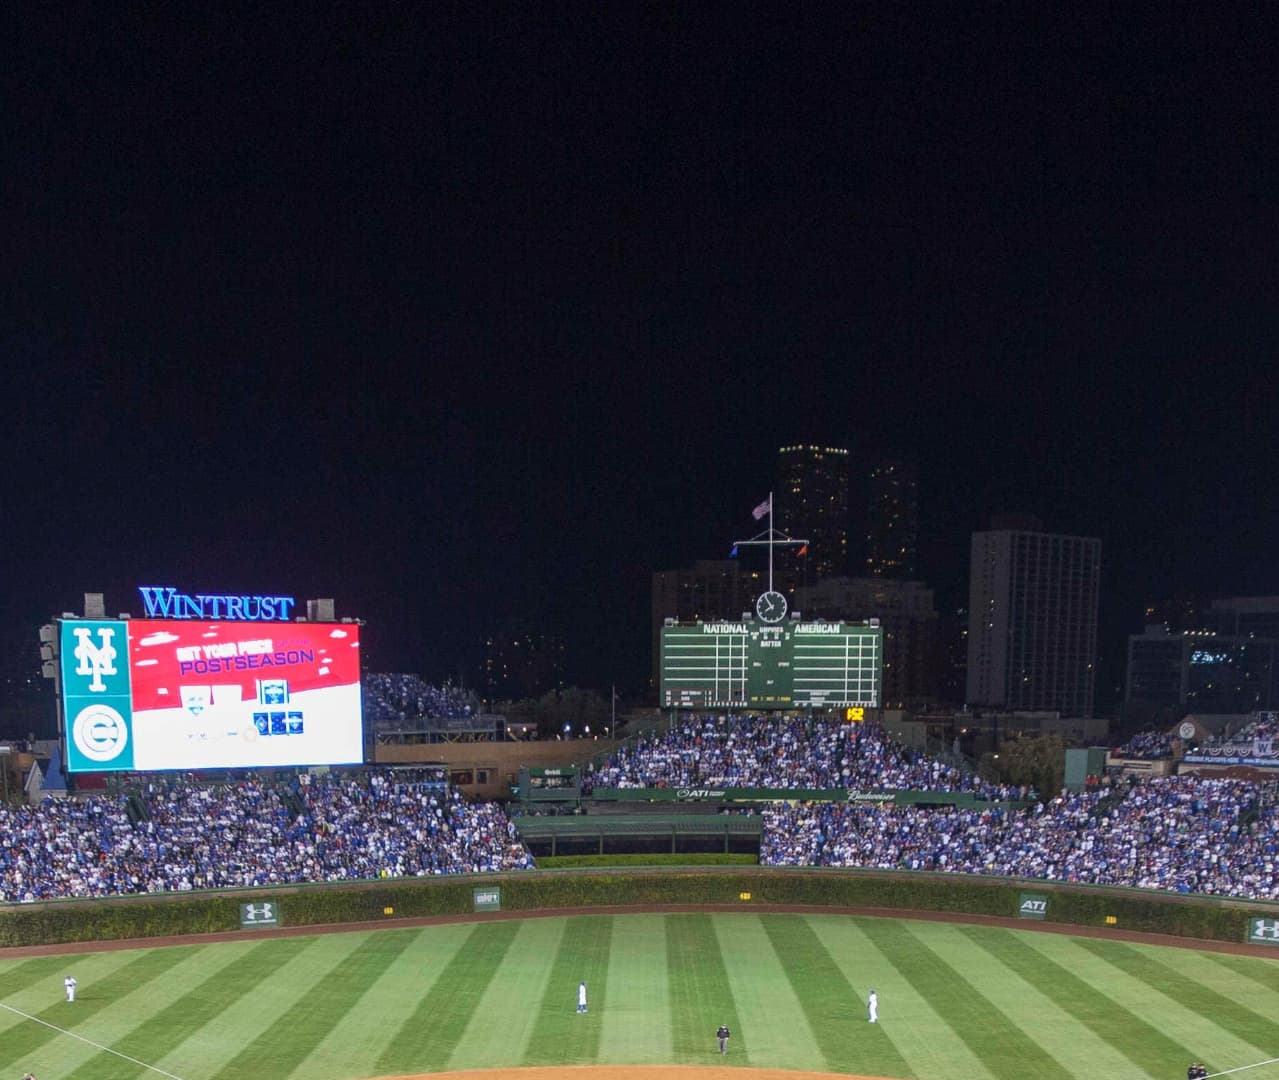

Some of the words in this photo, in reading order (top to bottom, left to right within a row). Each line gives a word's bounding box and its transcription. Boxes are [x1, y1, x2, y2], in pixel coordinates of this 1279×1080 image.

[138, 587, 295, 620] WINTRUST
[704, 624, 748, 633] NATIONAL
[794, 624, 840, 633] AMERICAN
[180, 649, 315, 676] POSTSEASON
[847, 789, 895, 800] Budweiser
[1021, 900, 1047, 910] ATI
